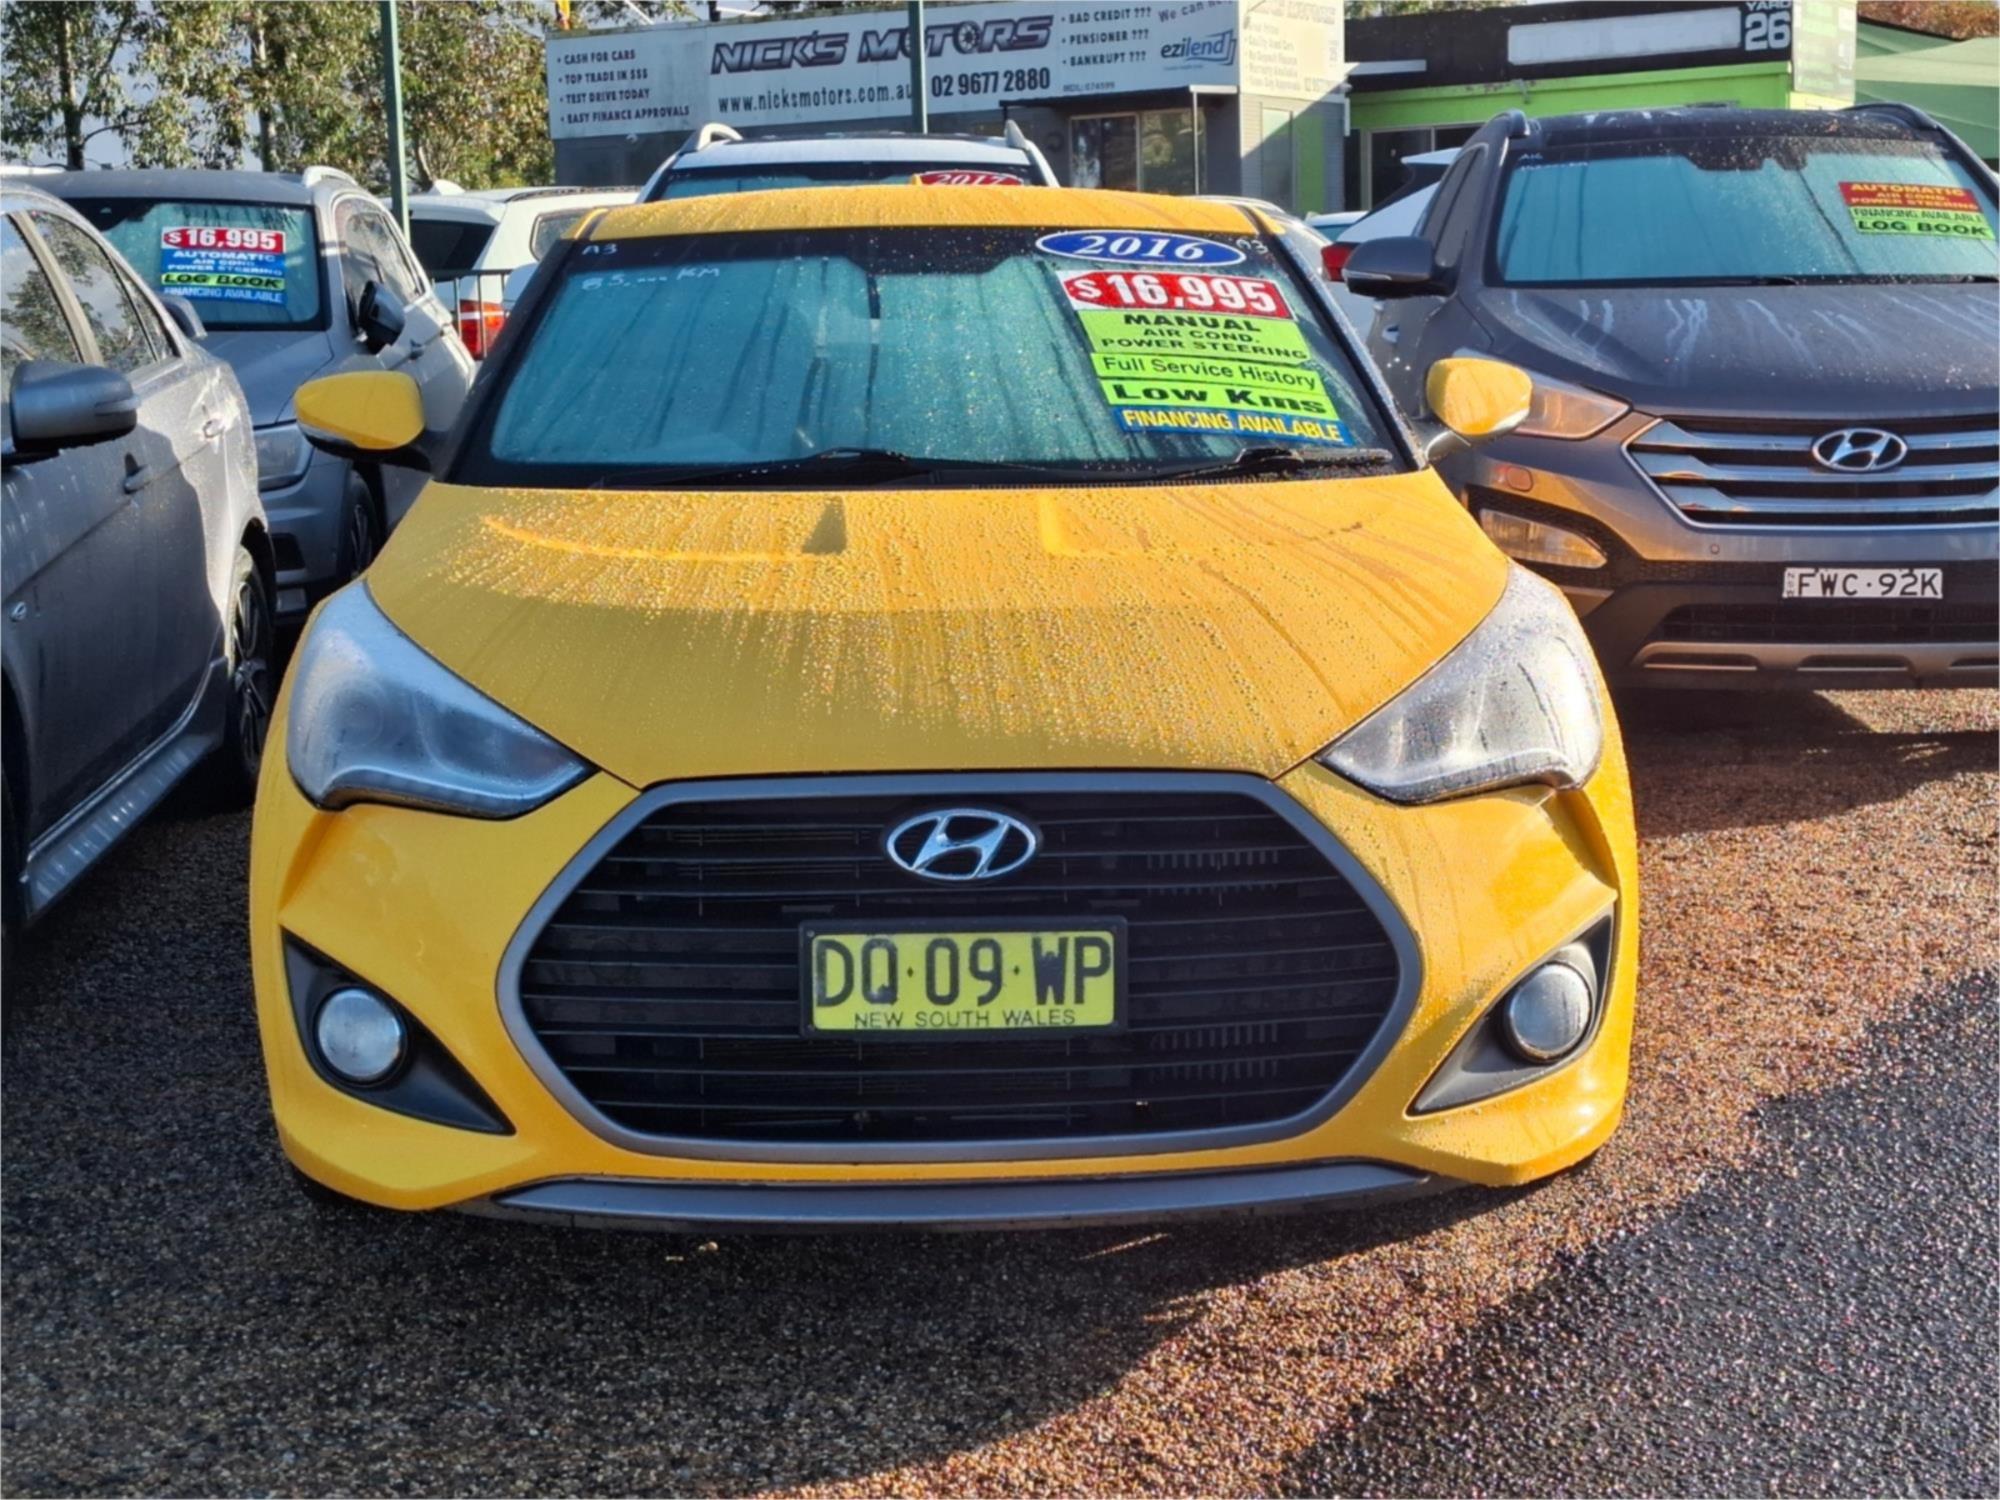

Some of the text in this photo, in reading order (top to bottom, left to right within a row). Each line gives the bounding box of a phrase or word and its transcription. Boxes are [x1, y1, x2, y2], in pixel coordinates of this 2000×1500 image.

[1158, 9, 1176, 23] We
[1181, 2, 1204, 15] can
[1745, 0, 1792, 11] YARD
[1069, 12, 1090, 24] BAD
[1094, 8, 1131, 21] CREDIT
[1069, 30, 1128, 45] PENSIONER
[1745, 10, 1791, 51] 26
[710, 15, 1054, 75] NICK'S MTORS
[1160, 34, 1226, 59] ezilend
[564, 49, 636, 65] CASH FOR CARS
[1070, 51, 1126, 67] BANKRUPT
[565, 73, 582, 85] TOP
[585, 71, 614, 83] TRADE
[931, 67, 1050, 97] 02 9677 2880
[566, 88, 650, 104] TEST DRIVE TODAY
[567, 105, 690, 124] EASY FINANCE APPROVALS
[1851, 183, 1967, 197] AUTOMATIC
[1858, 220, 1987, 236] LOG BOOK
[168, 229, 277, 250] $16,995
[1074, 236, 1205, 260] 2016
[172, 250, 275, 262] AUTOMATIC
[164, 274, 279, 289] LOG BOOK
[163, 287, 283, 303] FINANCING AVAILABLE
[1075, 274, 1277, 313] $16,995
[1124, 314, 1261, 332] MANUAL
[1144, 328, 1260, 344] AIR COND.
[1102, 338, 1308, 360] POWER STEERING
[1103, 356, 1316, 390] Full Service History
[1112, 384, 1327, 414] Low Kms
[1122, 410, 1342, 441] FINANCING AVAILABLE
[854, 1008, 1076, 1029] NEW SOUTH WALES
